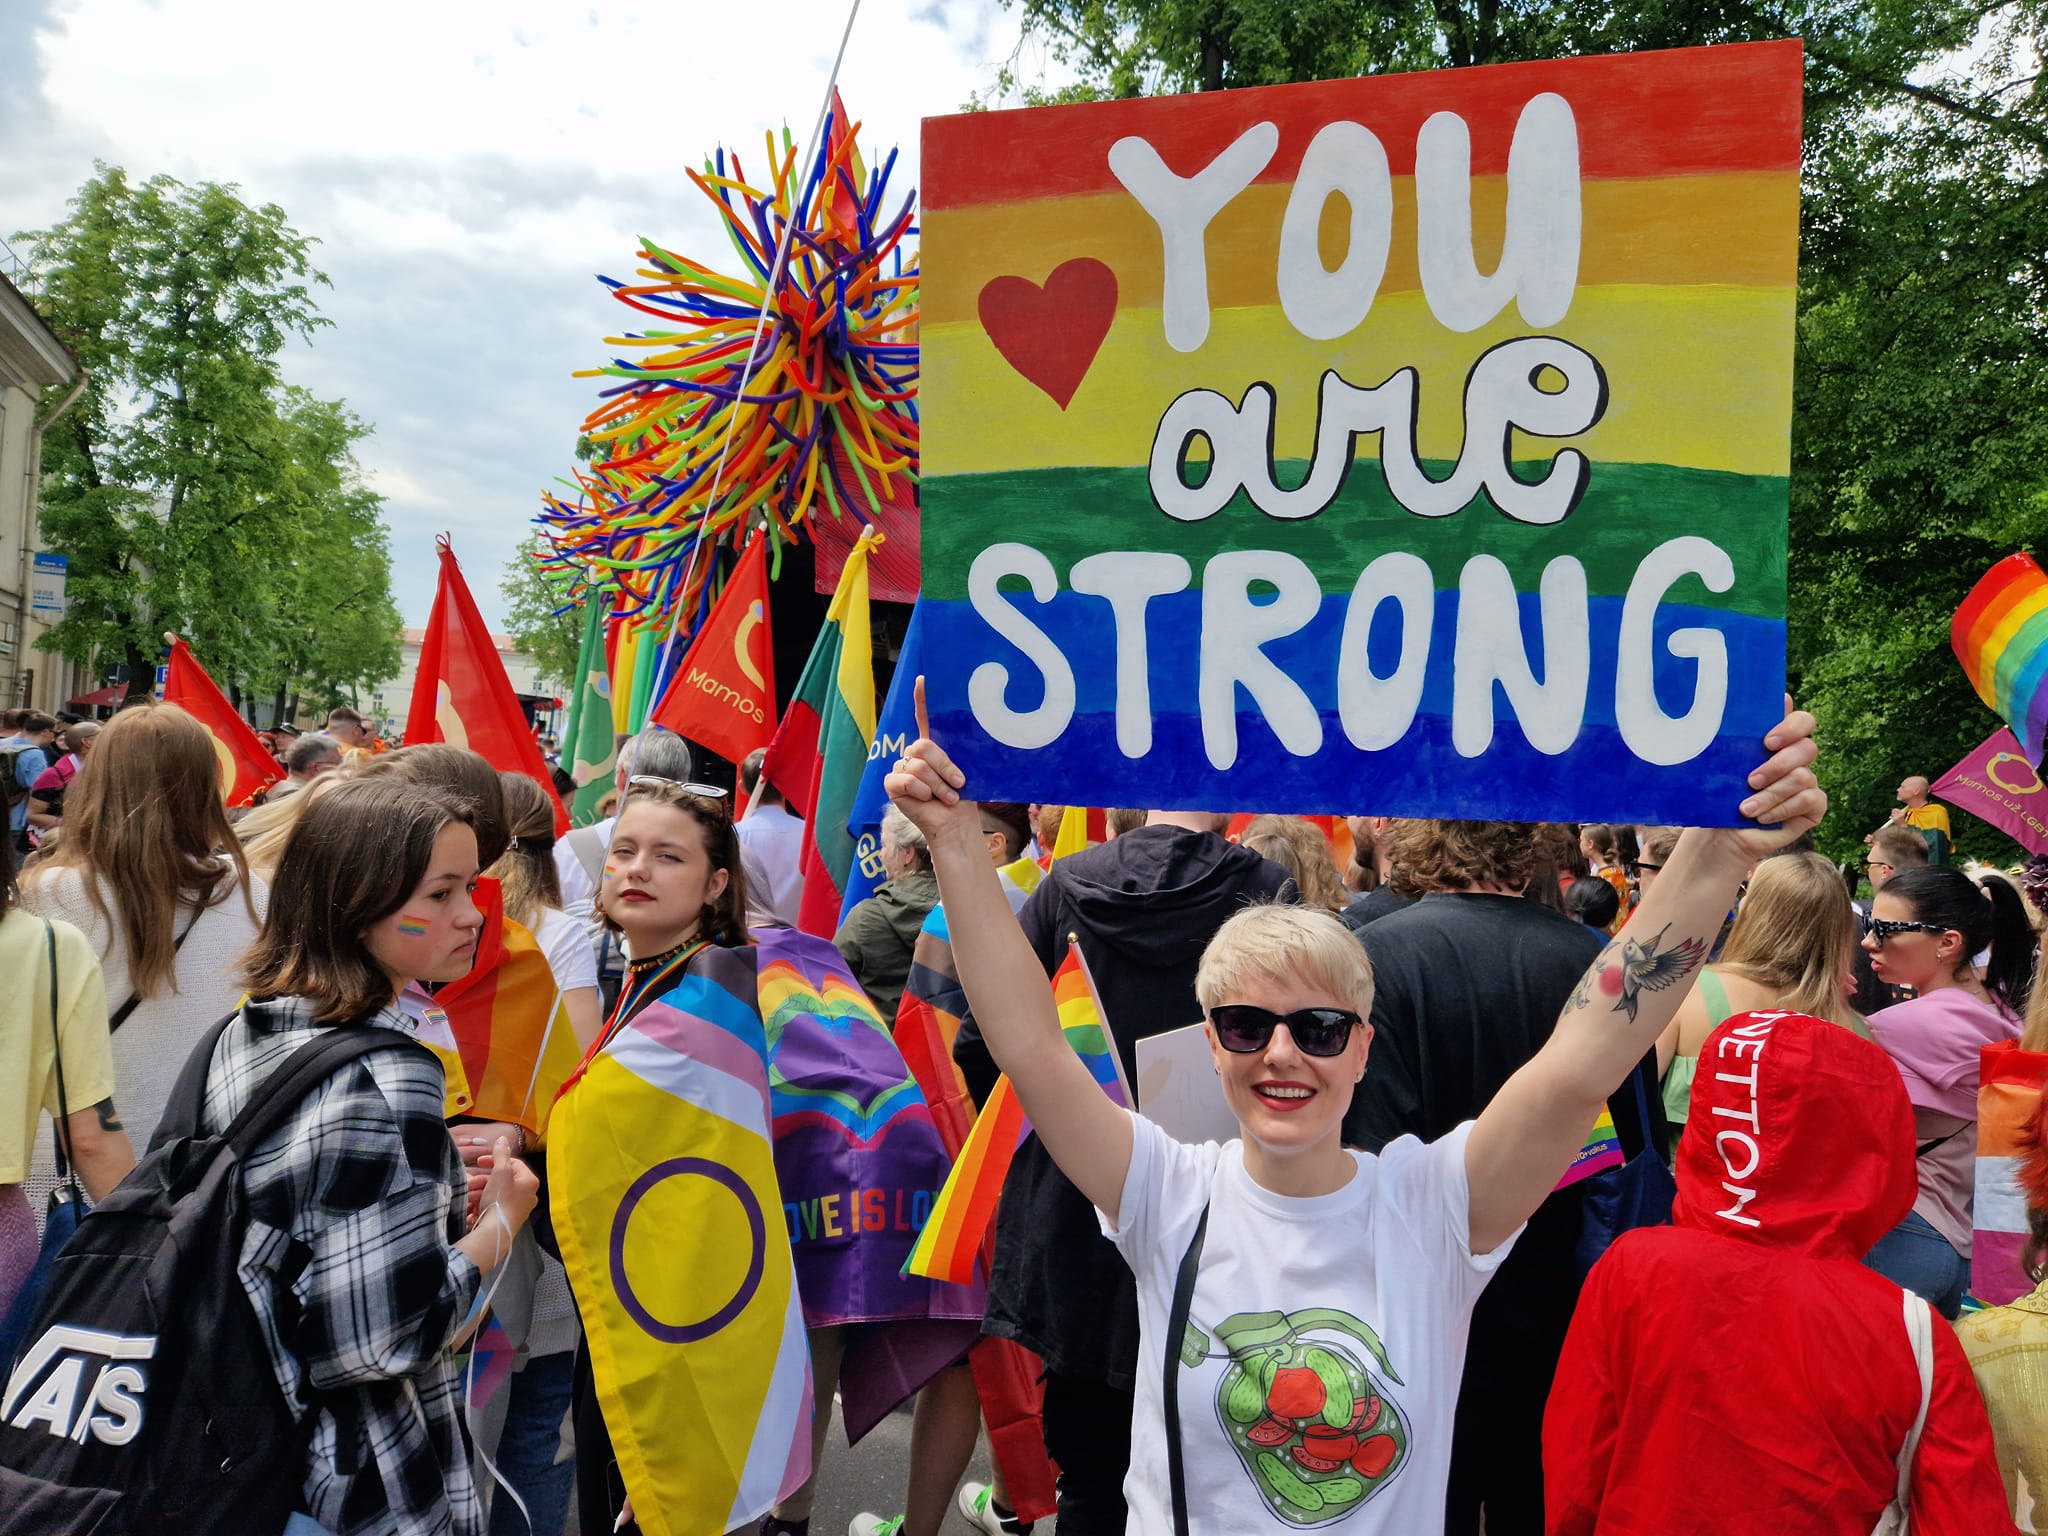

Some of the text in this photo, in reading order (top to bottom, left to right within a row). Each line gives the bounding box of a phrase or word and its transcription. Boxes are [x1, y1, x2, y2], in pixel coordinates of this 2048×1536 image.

[1108, 92, 1584, 352] YOU
[1148, 336, 1609, 525] are
[686, 667, 765, 724] Mamos
[967, 536, 1735, 771] STRONG
[1954, 774, 2003, 801] Mamos
[1712, 1012, 1790, 1227] NETTON
[783, 1194, 843, 1244] OVE
[851, 1188, 886, 1233] IS
